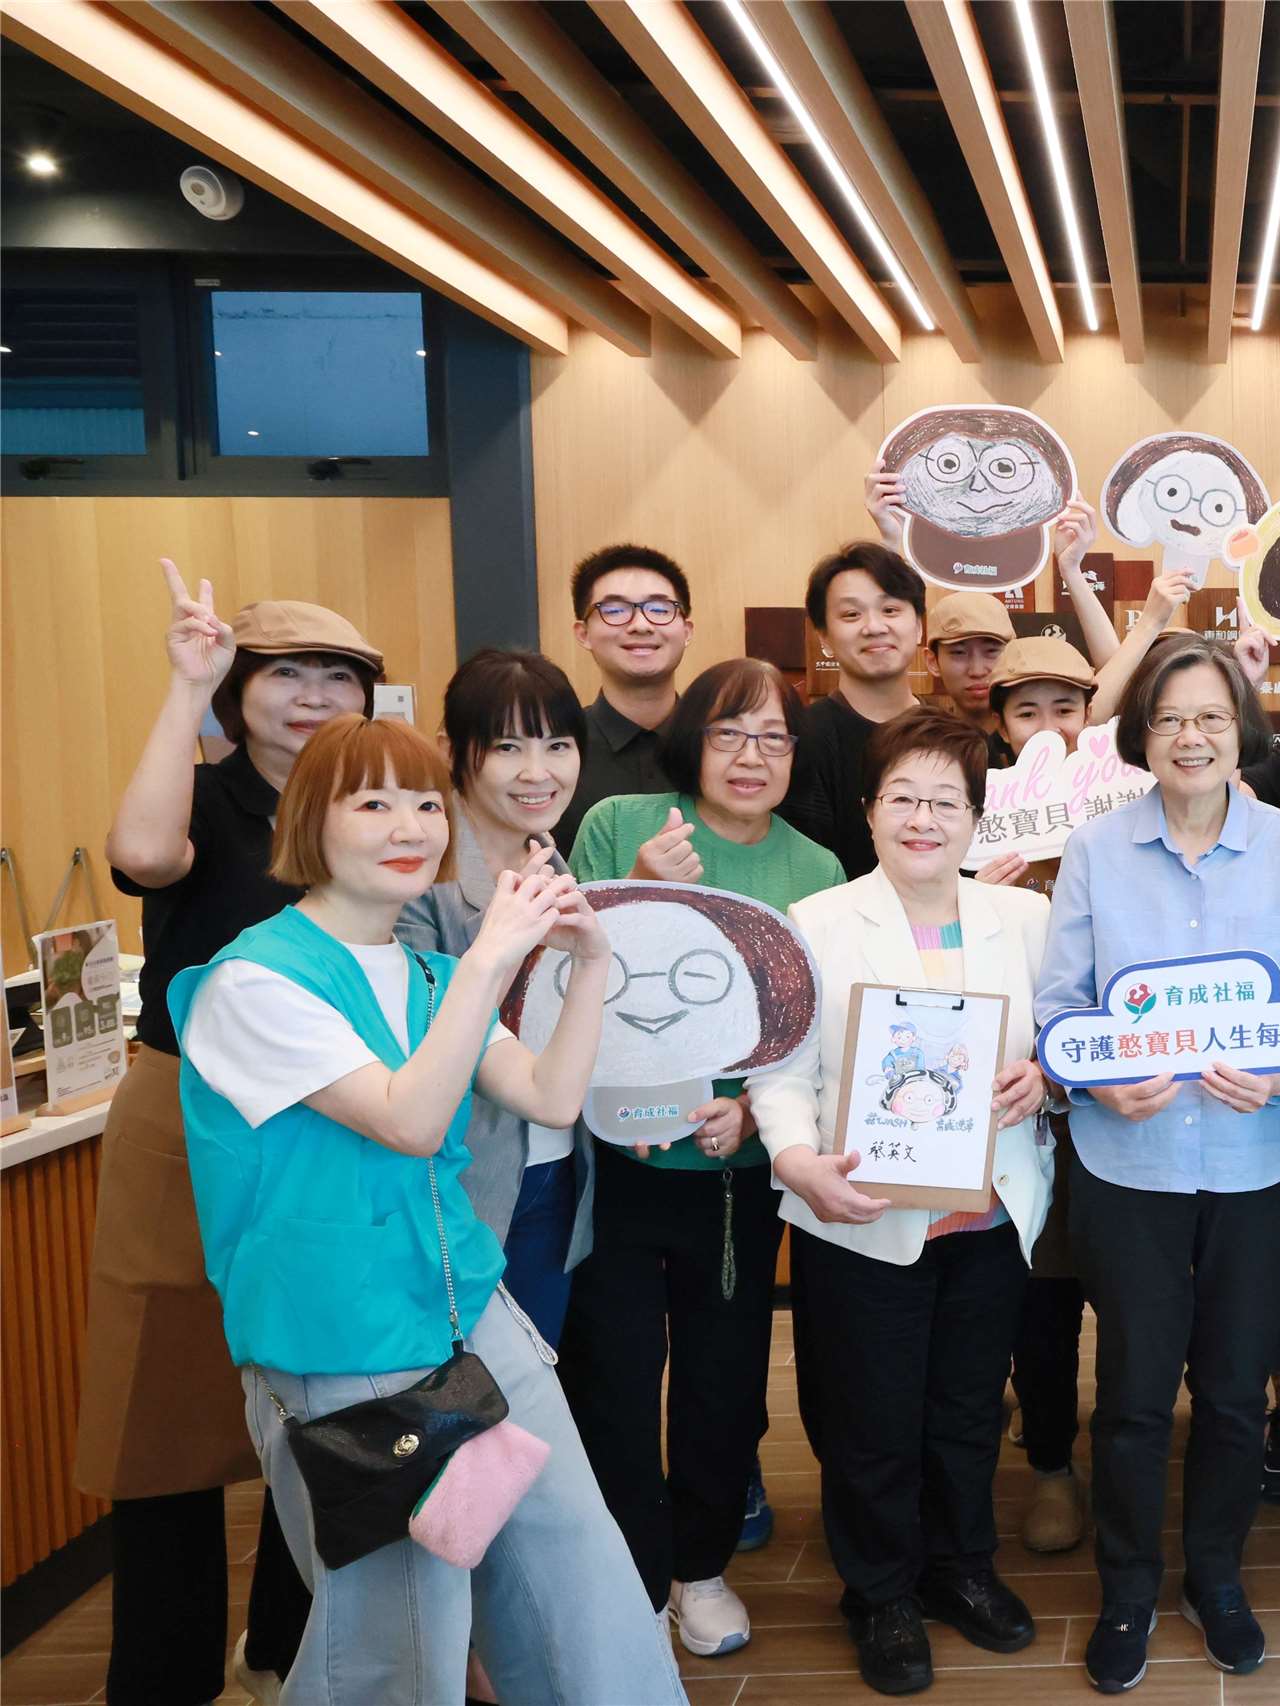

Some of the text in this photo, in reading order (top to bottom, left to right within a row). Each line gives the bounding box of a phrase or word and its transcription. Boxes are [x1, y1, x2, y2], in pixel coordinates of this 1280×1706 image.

[1204, 630, 1241, 641] 東和鋼
[1163, 980, 1256, 1007] 育成社福
[633, 1104, 680, 1119] 育成社福
[867, 1140, 917, 1163] 蔡英文
